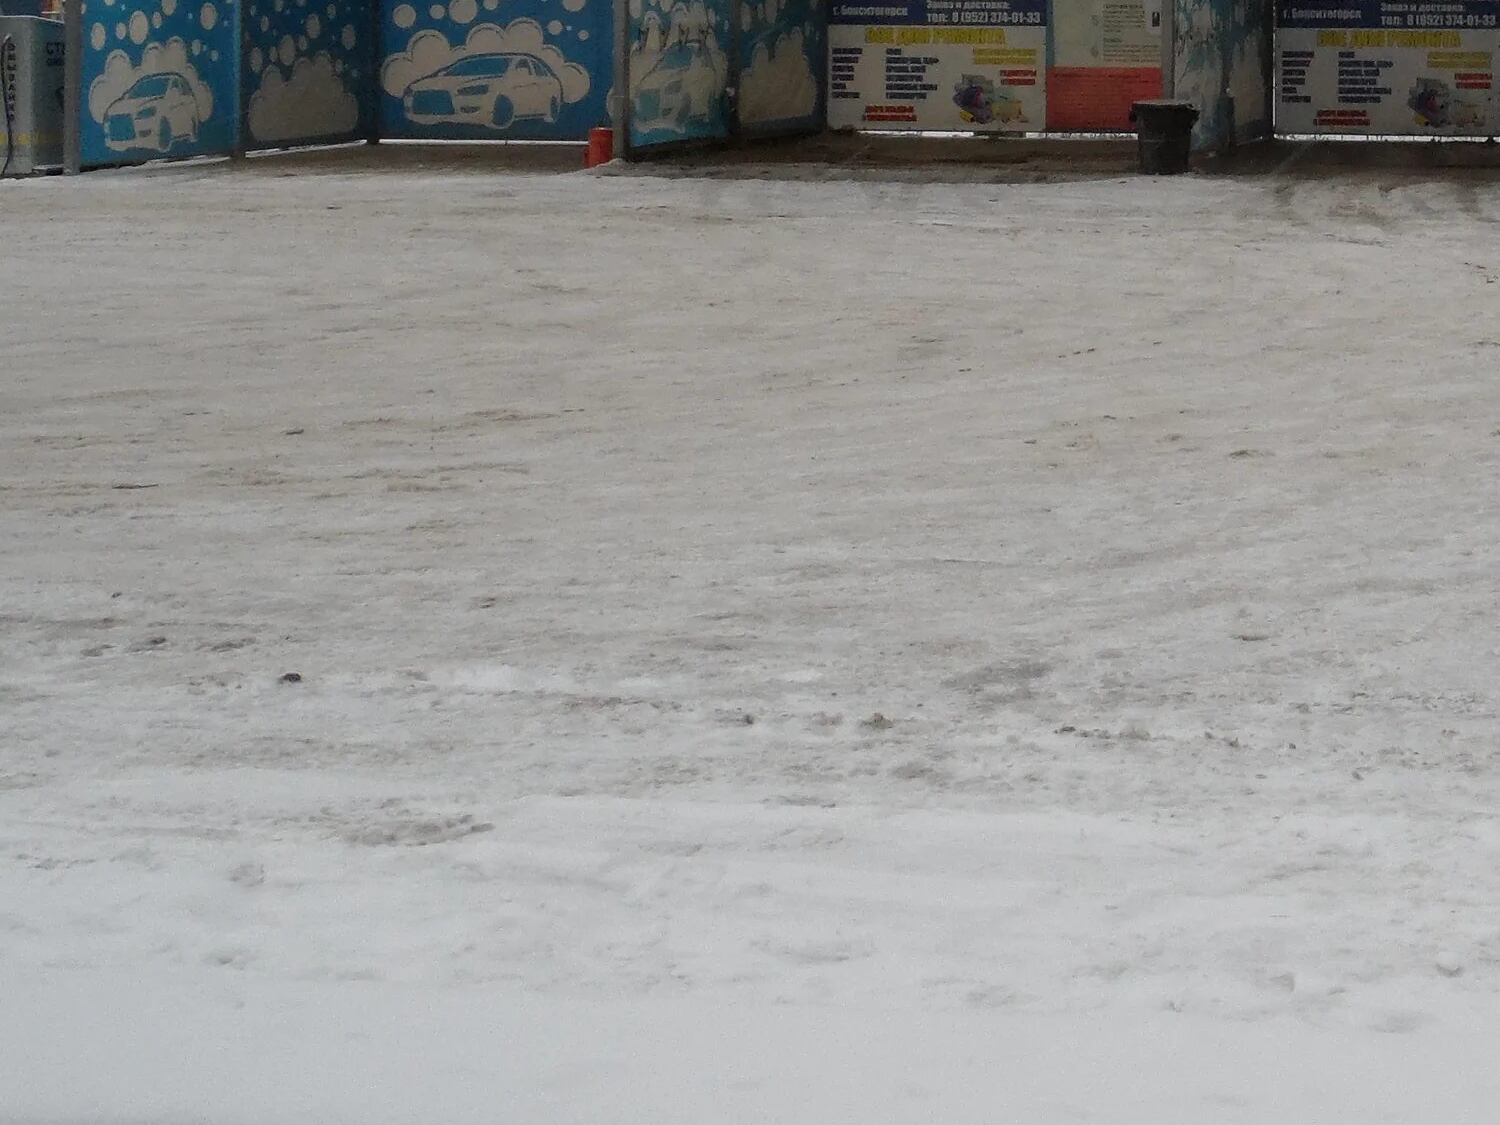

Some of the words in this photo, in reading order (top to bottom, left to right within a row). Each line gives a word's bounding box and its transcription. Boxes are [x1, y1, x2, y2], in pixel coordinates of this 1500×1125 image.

[952, 11, 959, 23] 8
[961, 11, 988, 24] (952)
[989, 11, 1041, 24] 374-01-33
[1444, 14, 1497, 27] 374-01-33
